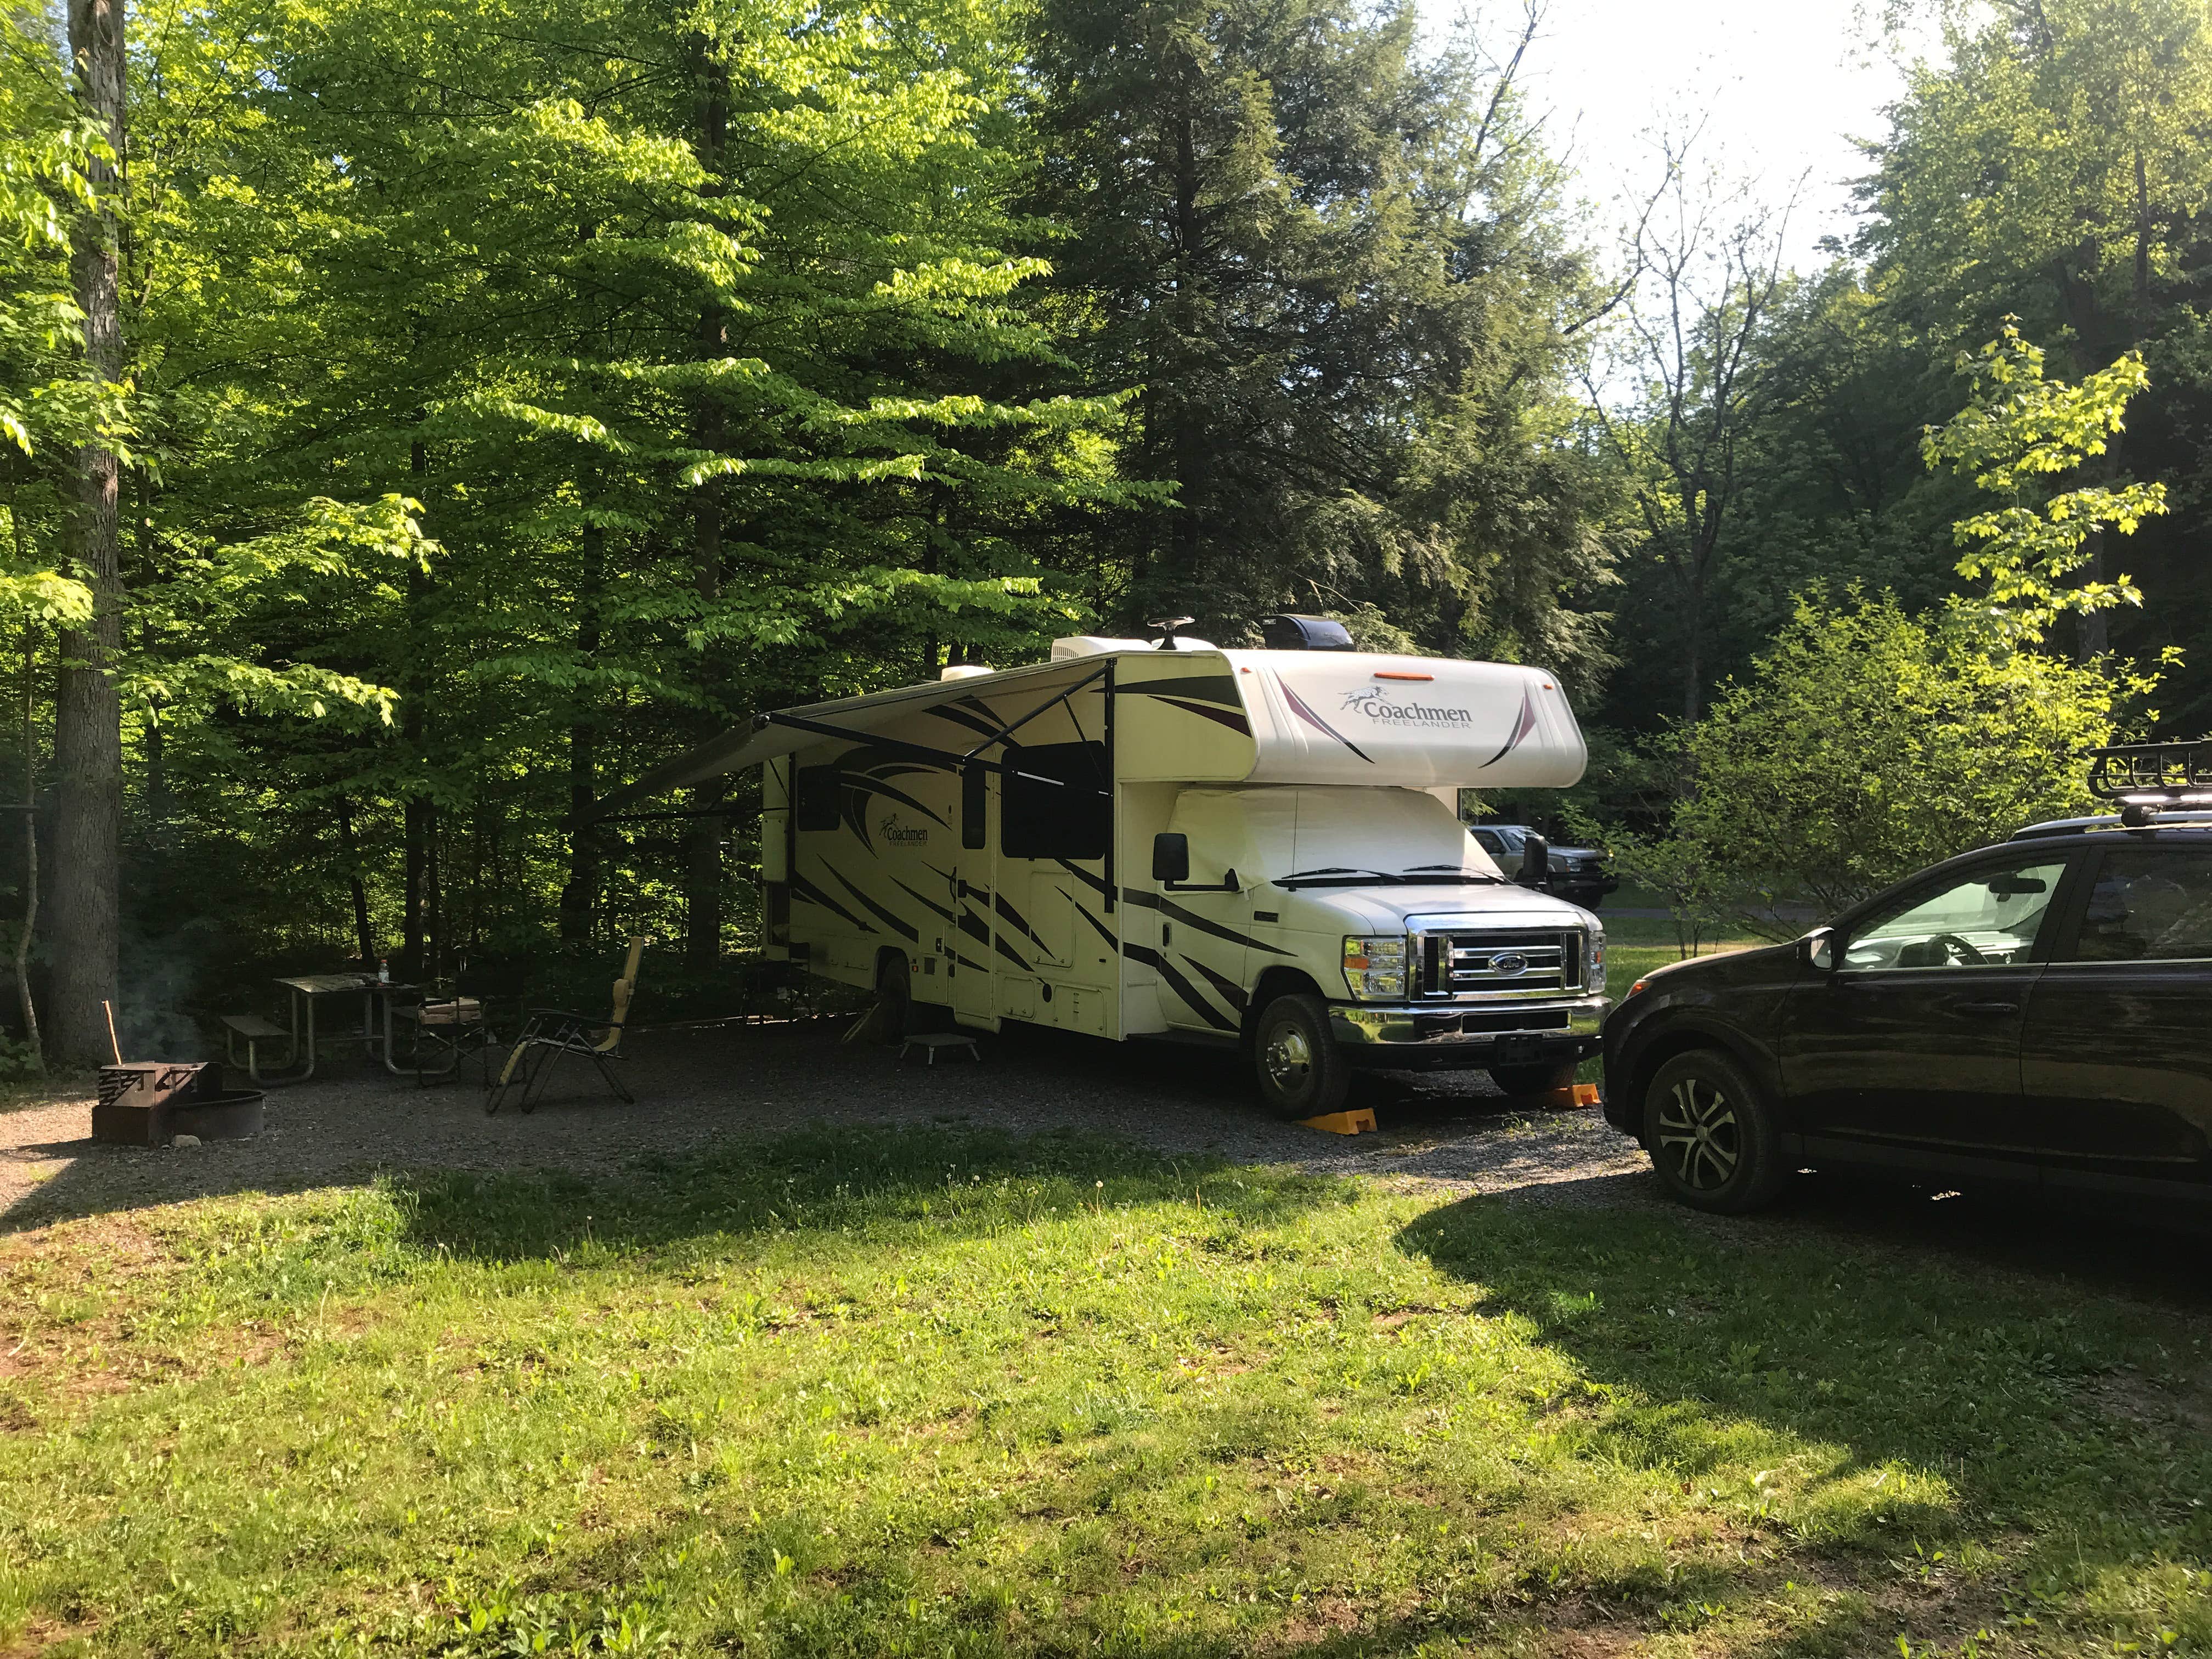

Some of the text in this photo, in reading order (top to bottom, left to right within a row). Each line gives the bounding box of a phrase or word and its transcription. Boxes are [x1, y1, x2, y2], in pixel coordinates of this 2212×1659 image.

[1364, 702, 1473, 722] Coachmen
[1373, 718, 1471, 729] FREELANDER
[887, 826, 928, 840] Coachmen
